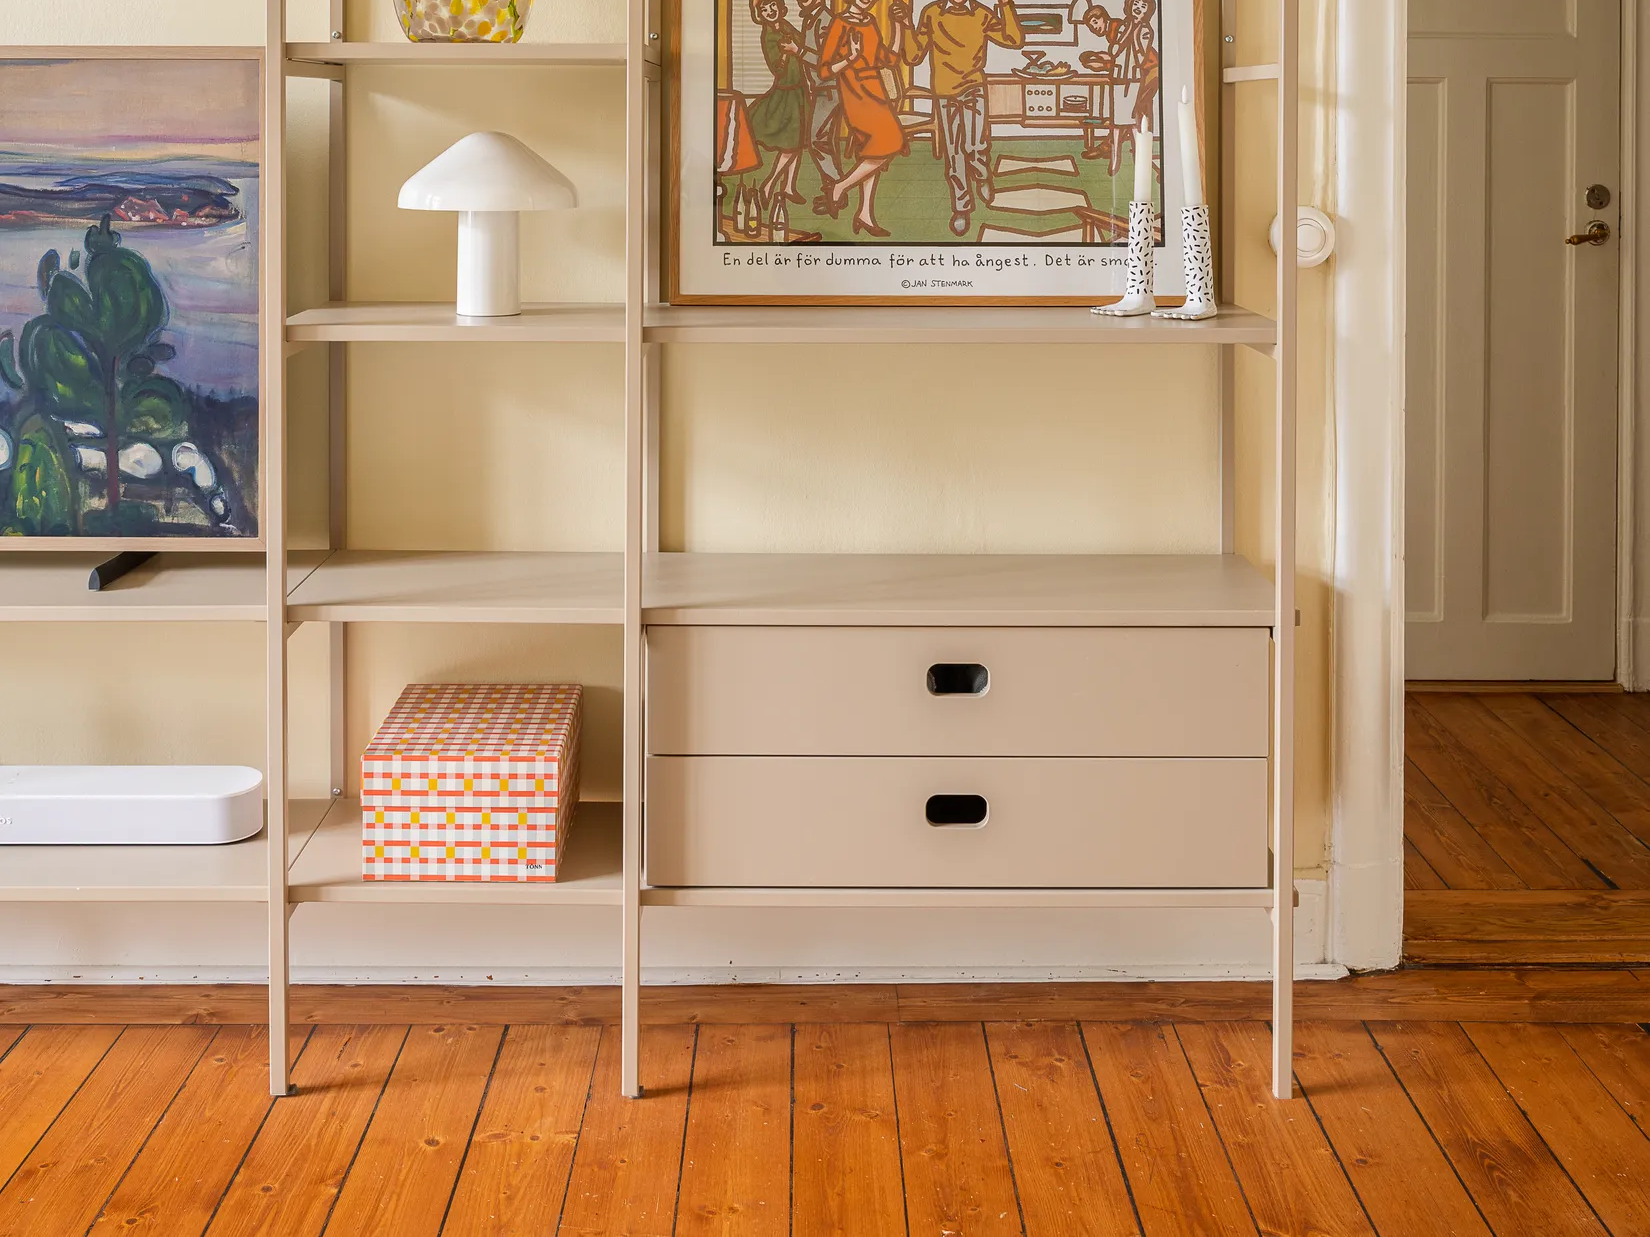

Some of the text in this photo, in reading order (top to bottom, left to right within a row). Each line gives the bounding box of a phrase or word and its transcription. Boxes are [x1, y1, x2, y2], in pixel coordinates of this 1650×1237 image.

[723, 252, 741, 266] En
[746, 251, 768, 266] del
[774, 252, 791, 266] är
[796, 251, 821, 269] för
[825, 251, 882, 267] dumma
[889, 252, 915, 269] för
[919, 251, 946, 267] att
[952, 253, 970, 267] ha
[976, 252, 1037, 272] ångest.
[1045, 253, 1072, 267] Det
[1077, 255, 1095, 267] är
[930, 279, 974, 289] STENMARK
